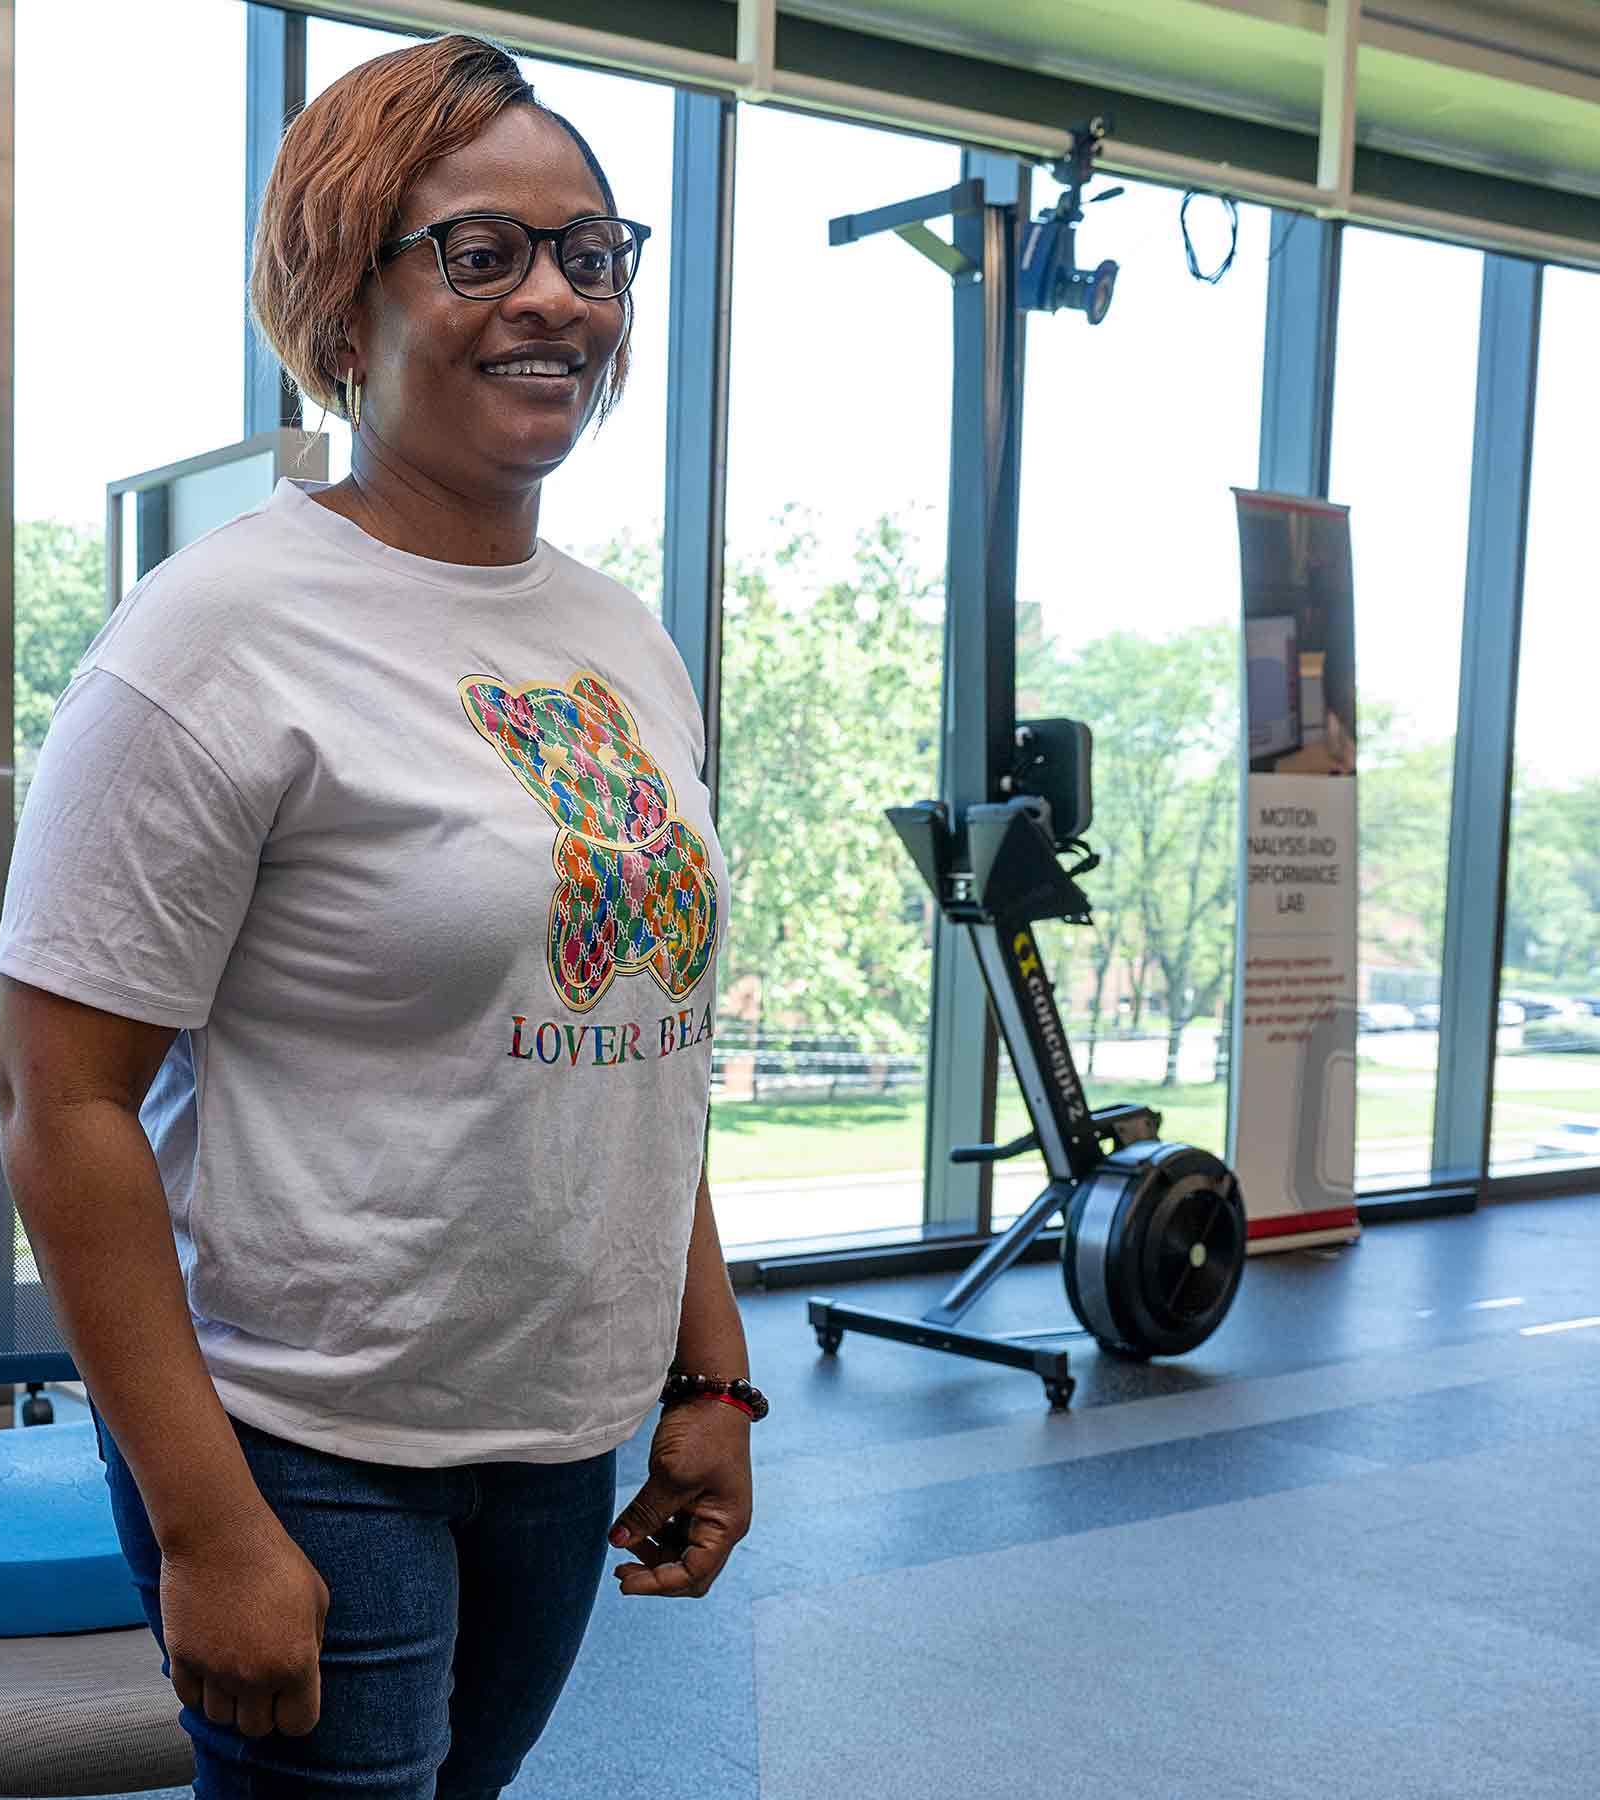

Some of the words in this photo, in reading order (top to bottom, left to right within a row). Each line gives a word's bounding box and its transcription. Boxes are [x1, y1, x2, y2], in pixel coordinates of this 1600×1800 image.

[1260, 808, 1317, 828] MOTION
[1247, 836, 1306, 857] NALYSIS
[1247, 864, 1340, 886] ERFORMANCE
[1278, 892, 1305, 913] LAB
[507, 1015, 646, 1067] LOVER
[658, 1002, 714, 1058] BEA
